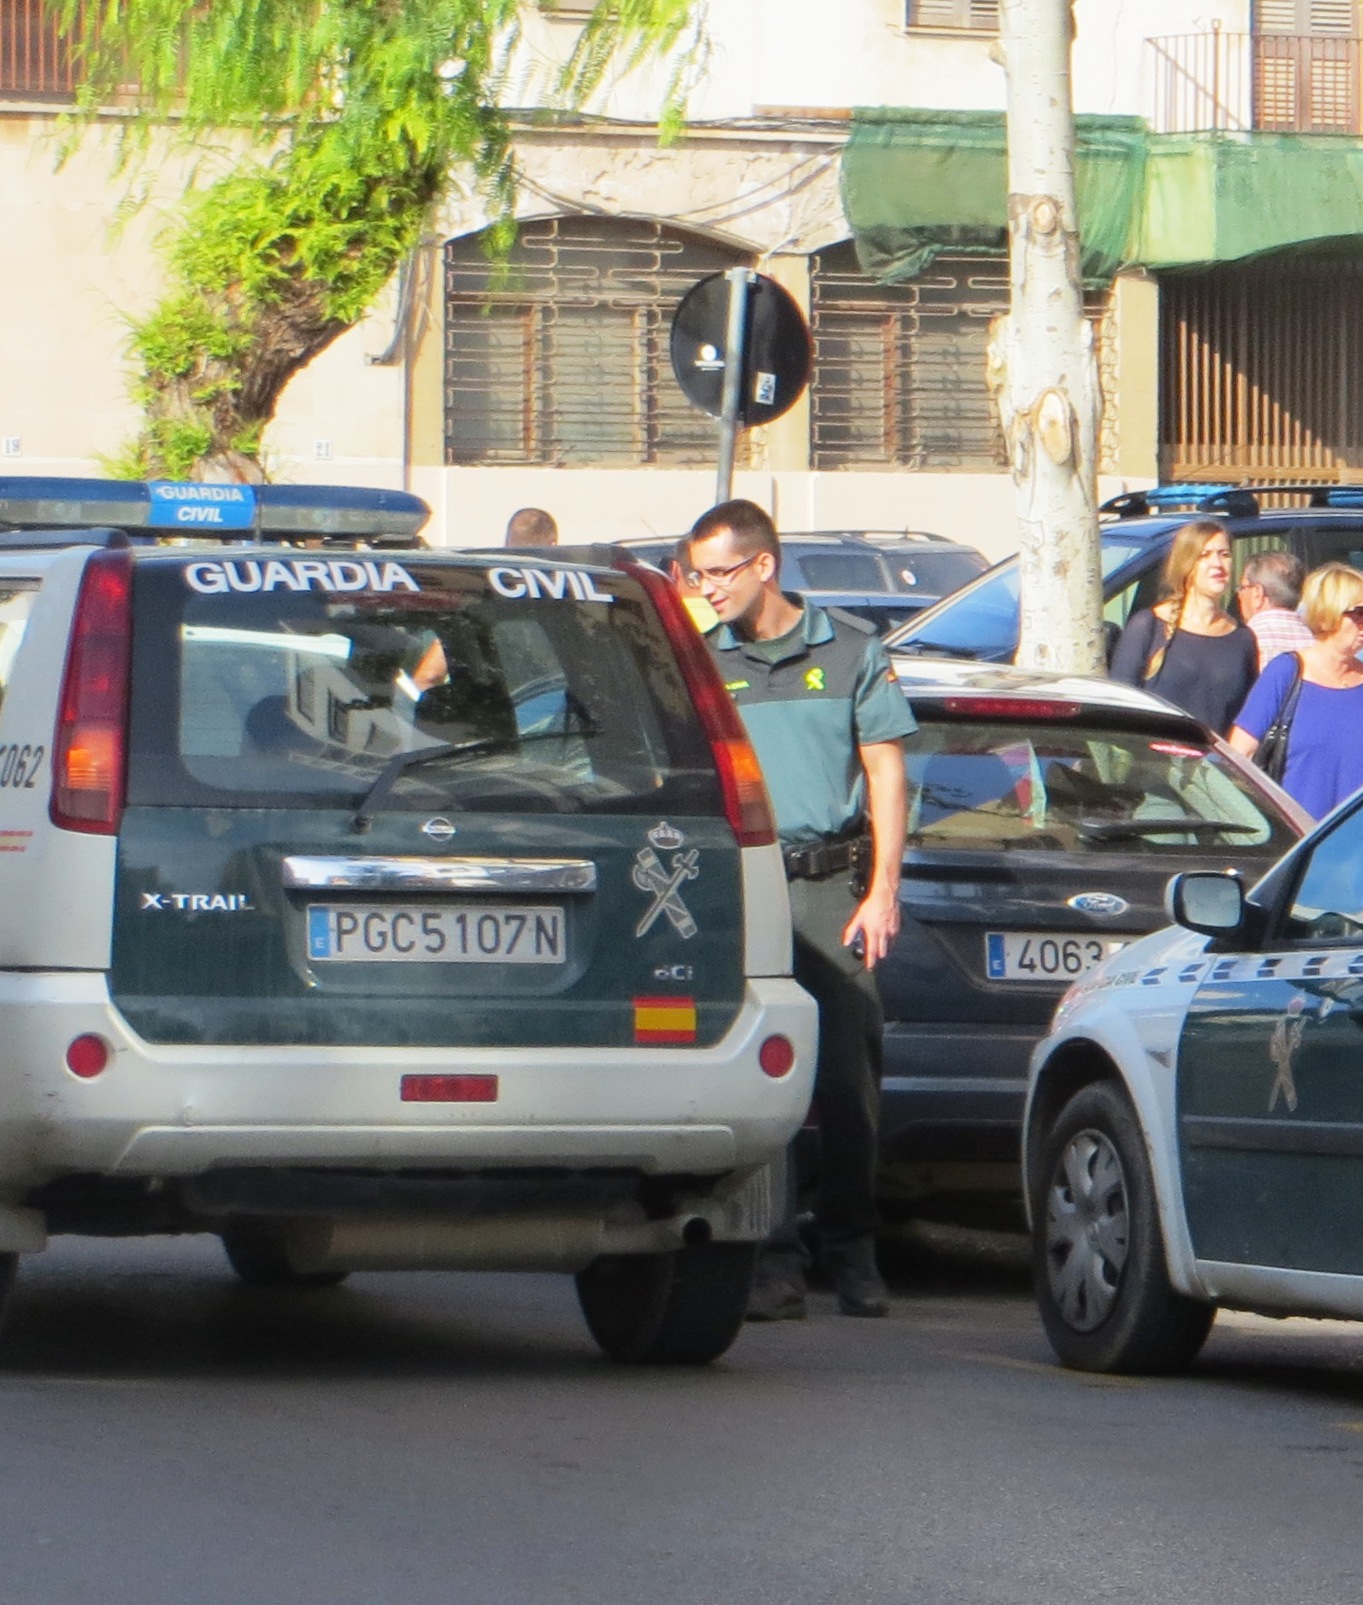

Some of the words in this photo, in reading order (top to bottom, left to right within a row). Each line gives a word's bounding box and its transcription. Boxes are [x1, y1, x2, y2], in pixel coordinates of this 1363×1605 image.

[158, 485, 244, 502] GUARDIA
[177, 506, 223, 523] CIVIL
[185, 561, 420, 593] GUARDIA
[487, 566, 614, 603] CIVIL
[0, 744, 44, 788] 062
[141, 892, 256, 911] X-TRAIL
[335, 911, 559, 956] PGC5107N
[1017, 939, 1103, 974] 4063
